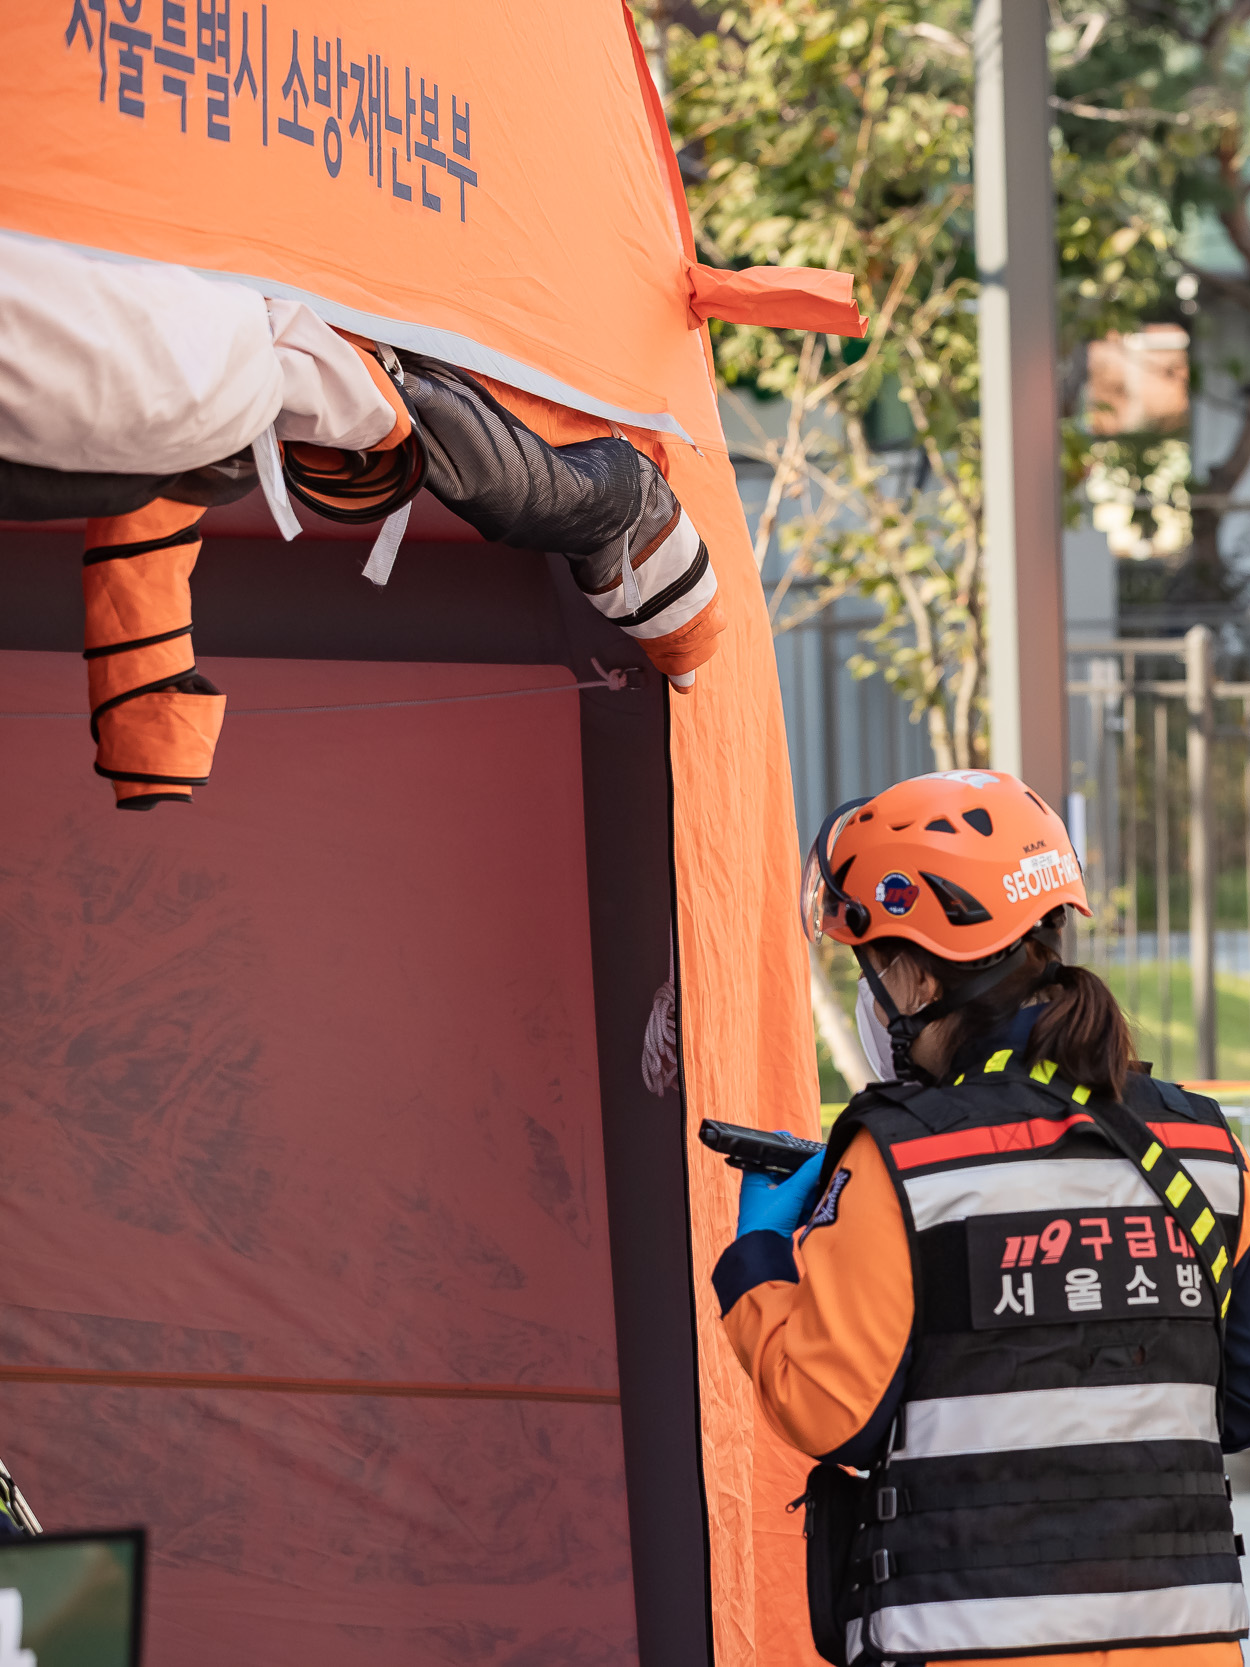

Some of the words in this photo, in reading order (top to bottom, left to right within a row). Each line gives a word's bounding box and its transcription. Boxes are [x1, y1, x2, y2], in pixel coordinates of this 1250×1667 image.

[65, 0, 268, 146] 서울특별시
[278, 29, 477, 223] 소방재난본부
[884, 885, 920, 908] 119
[1002, 865, 1060, 904] SEOUL
